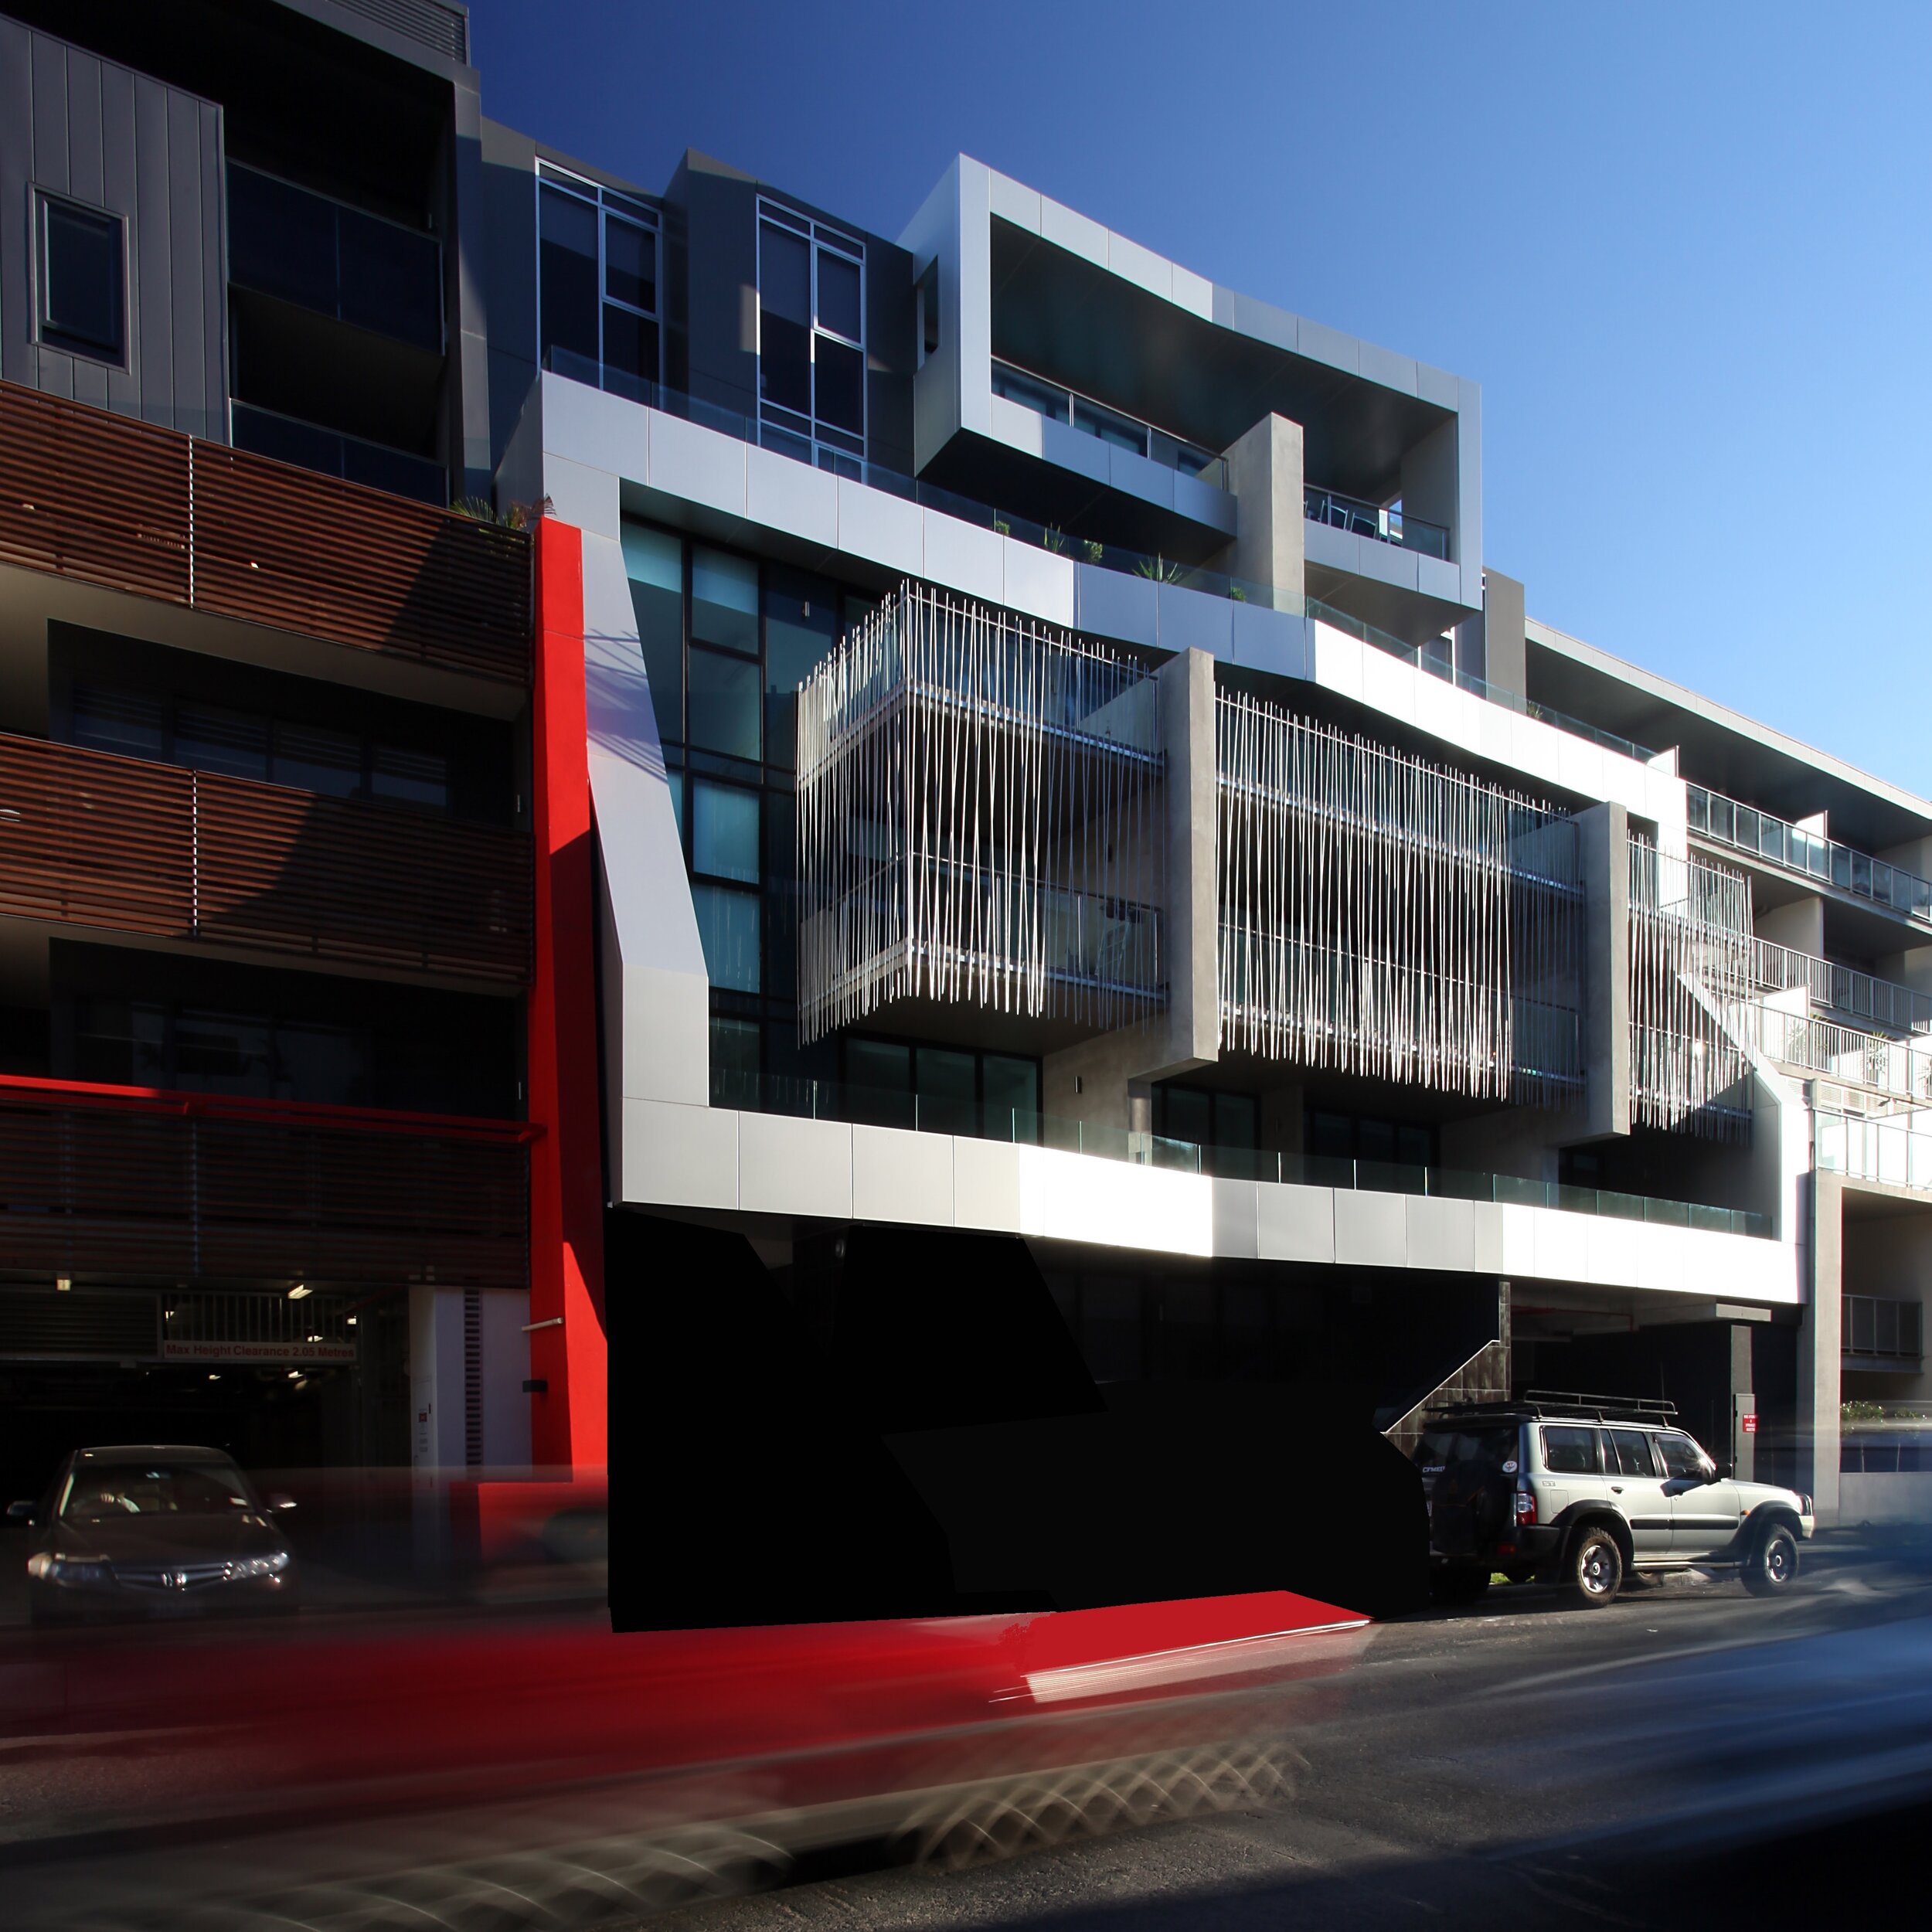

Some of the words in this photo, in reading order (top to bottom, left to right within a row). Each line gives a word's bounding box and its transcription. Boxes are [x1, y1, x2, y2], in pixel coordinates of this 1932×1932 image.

[166, 1345, 189, 1355] Max
[195, 1345, 230, 1357] Height
[233, 1345, 289, 1357] Clearance
[293, 1347, 315, 1357] 2.05
[318, 1347, 354, 1358] Metres
